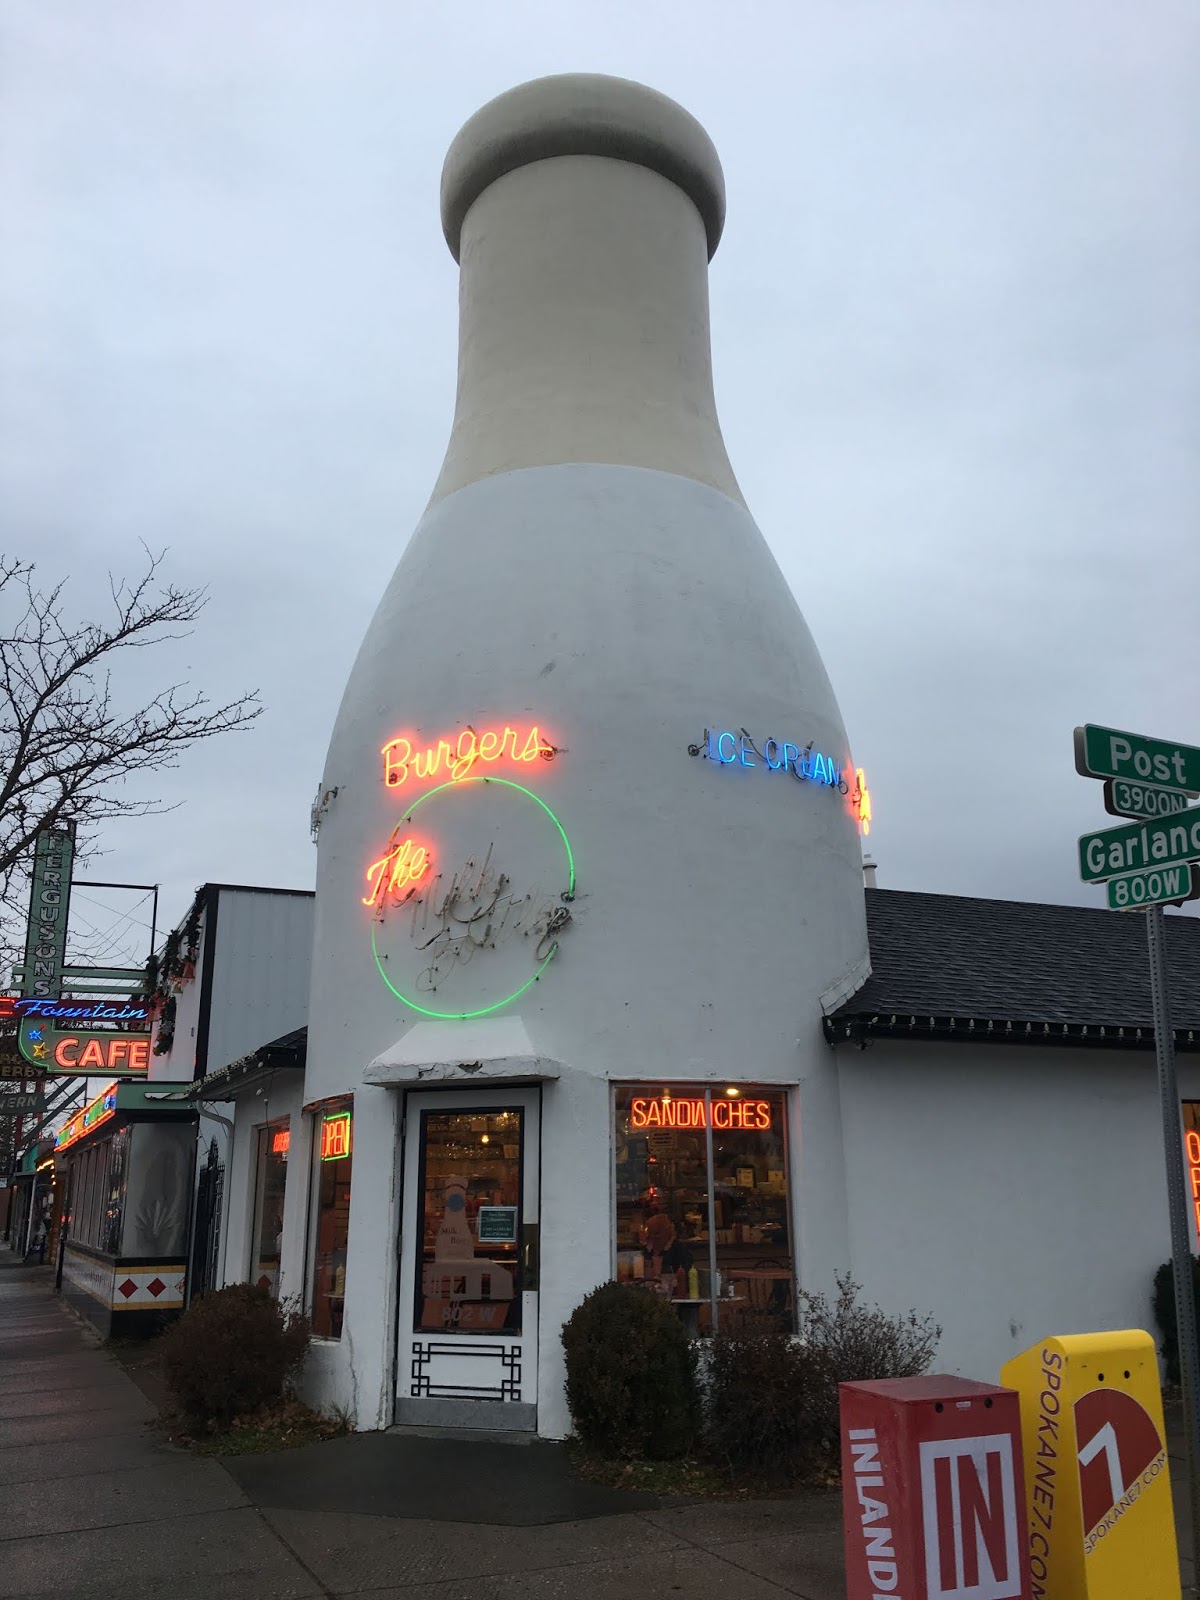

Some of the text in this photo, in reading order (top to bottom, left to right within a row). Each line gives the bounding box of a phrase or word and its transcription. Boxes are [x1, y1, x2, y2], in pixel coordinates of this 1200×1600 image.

[381, 727, 553, 787] Burgers
[708, 730, 756, 768] ICE
[1110, 735, 1187, 785] Post
[1118, 784, 1184, 816] 3900N
[362, 840, 429, 906] The
[1115, 868, 1181, 906] 800W
[32, 834, 65, 997] FERGUSON'S
[14, 999, 149, 1019] Fountain
[54, 1038, 149, 1069] CAFE
[631, 1099, 771, 1129] SANDWICHES
[321, 1117, 349, 1158] OPEN
[848, 1428, 903, 1600] INLAND
[1084, 1452, 1167, 1556] SPOKANE7.COM
